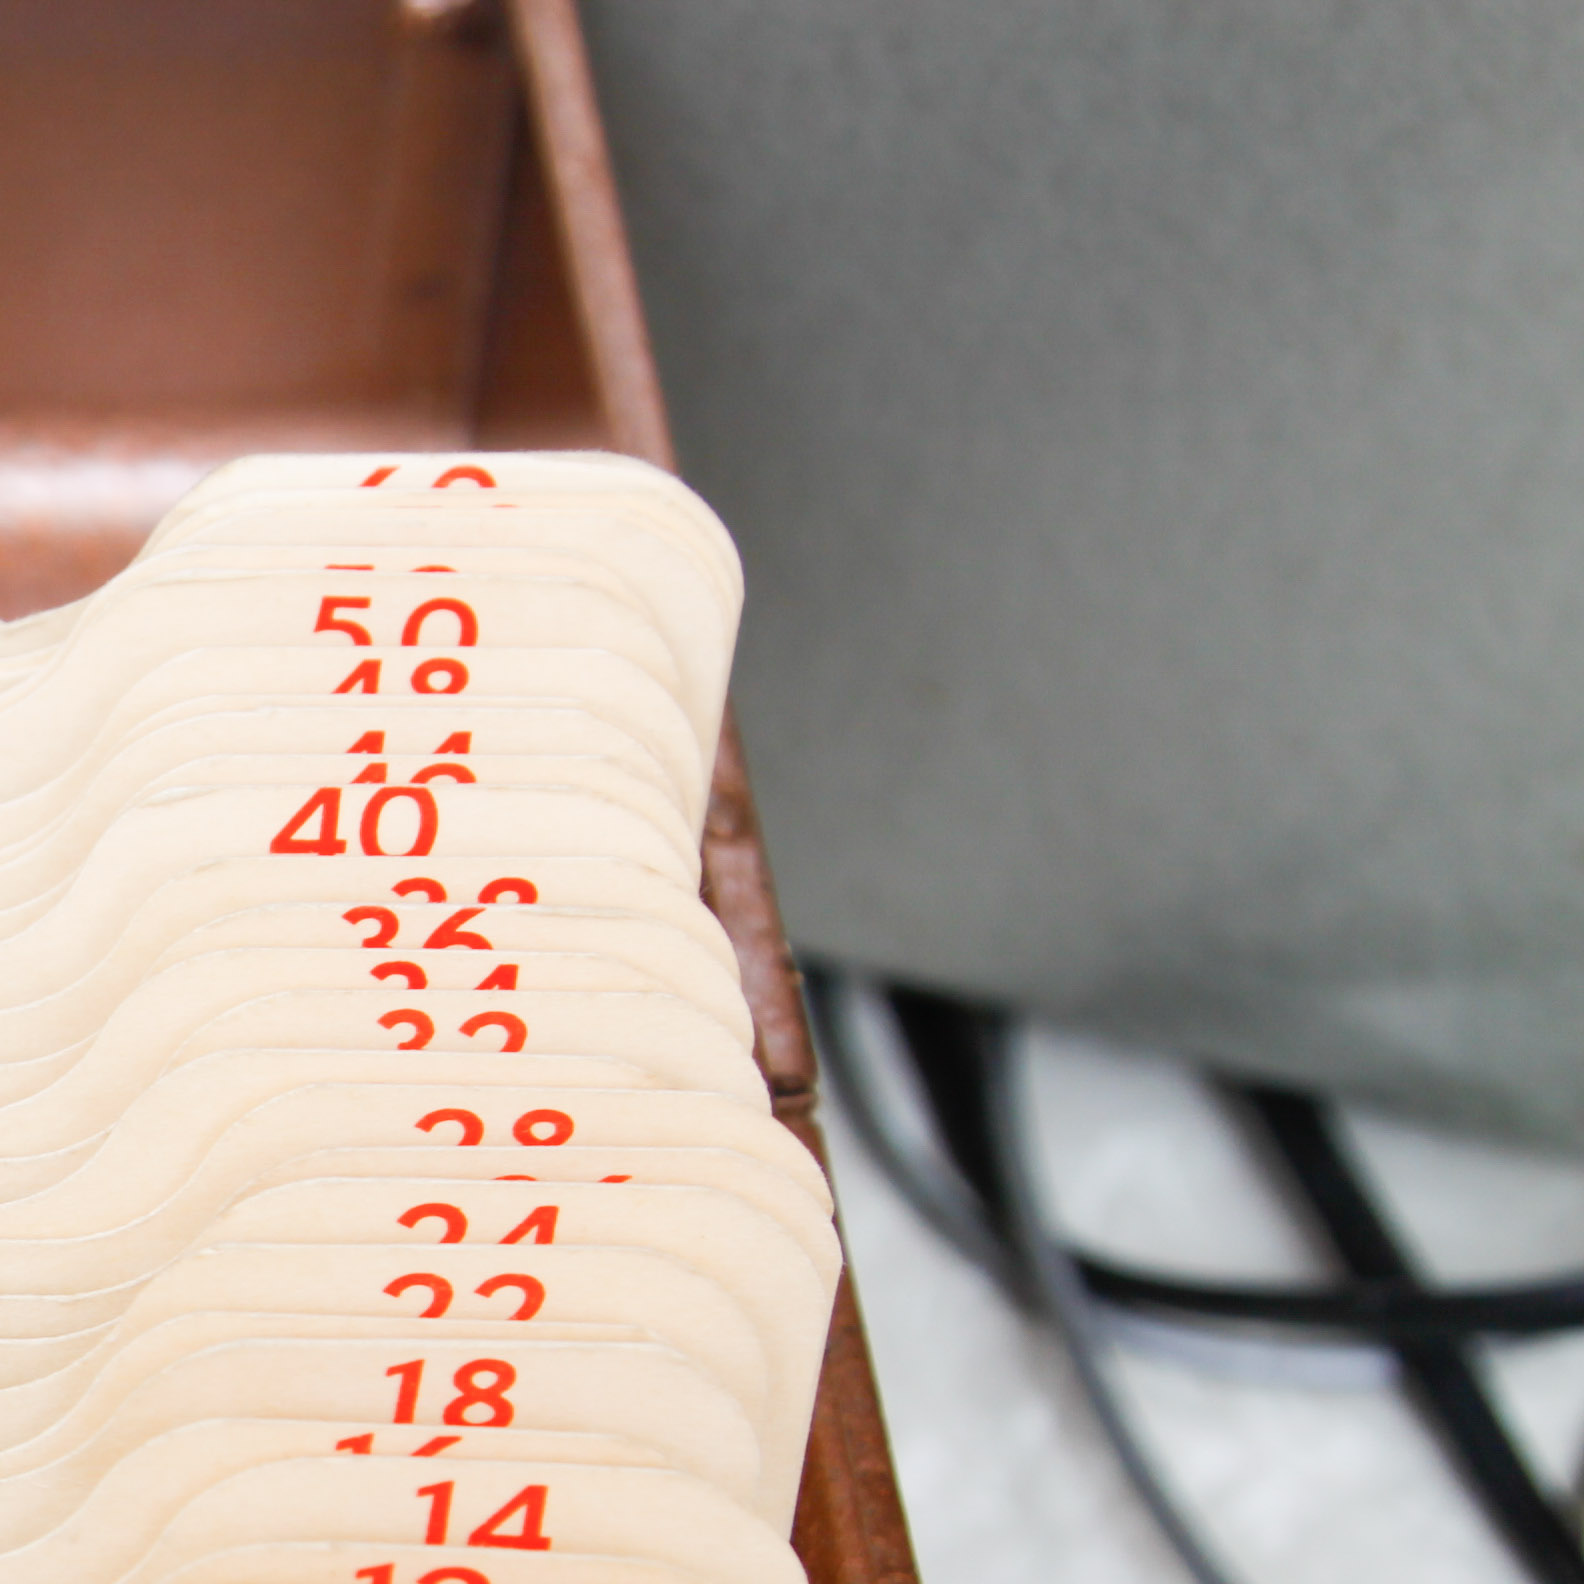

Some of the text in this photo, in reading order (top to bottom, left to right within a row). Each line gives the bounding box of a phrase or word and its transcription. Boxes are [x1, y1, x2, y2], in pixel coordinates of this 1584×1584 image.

[269, 785, 440, 857] 40
[384, 1357, 518, 1429] 18
[415, 1479, 554, 1552] 14
